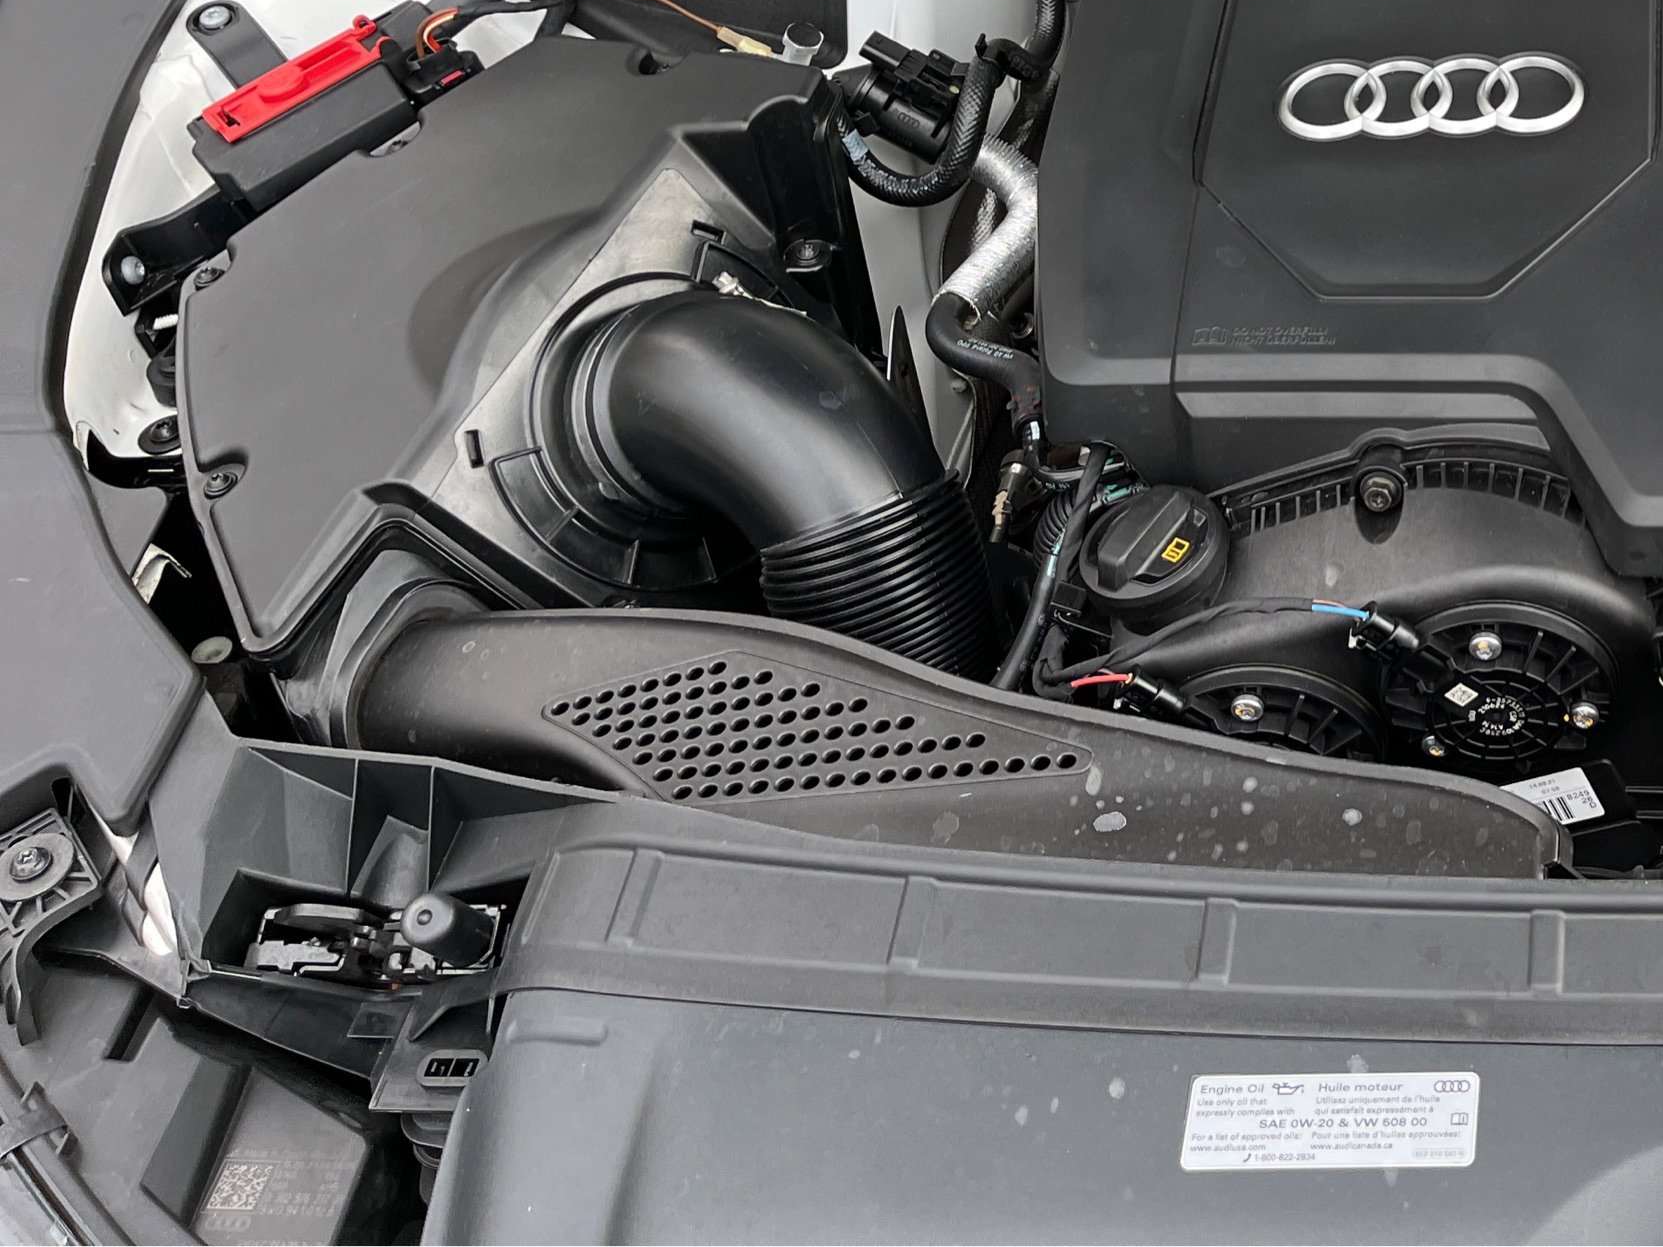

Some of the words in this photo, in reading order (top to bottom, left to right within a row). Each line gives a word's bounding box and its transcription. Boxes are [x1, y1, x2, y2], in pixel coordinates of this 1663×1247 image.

[1200, 1084, 1243, 1096] Engine
[1247, 1084, 1265, 1094] Oil
[1318, 1082, 1350, 1093] Huile
[1354, 1083, 1404, 1093] moteur
[1216, 1098, 1235, 1107] only
[1276, 1107, 1295, 1115] with
[1259, 1119, 1287, 1129] SAE
[1290, 1118, 1334, 1129] 0W-20
[1338, 1118, 1349, 1128] &
[1354, 1117, 1378, 1127] VW
[1410, 1117, 1428, 1127] 00
